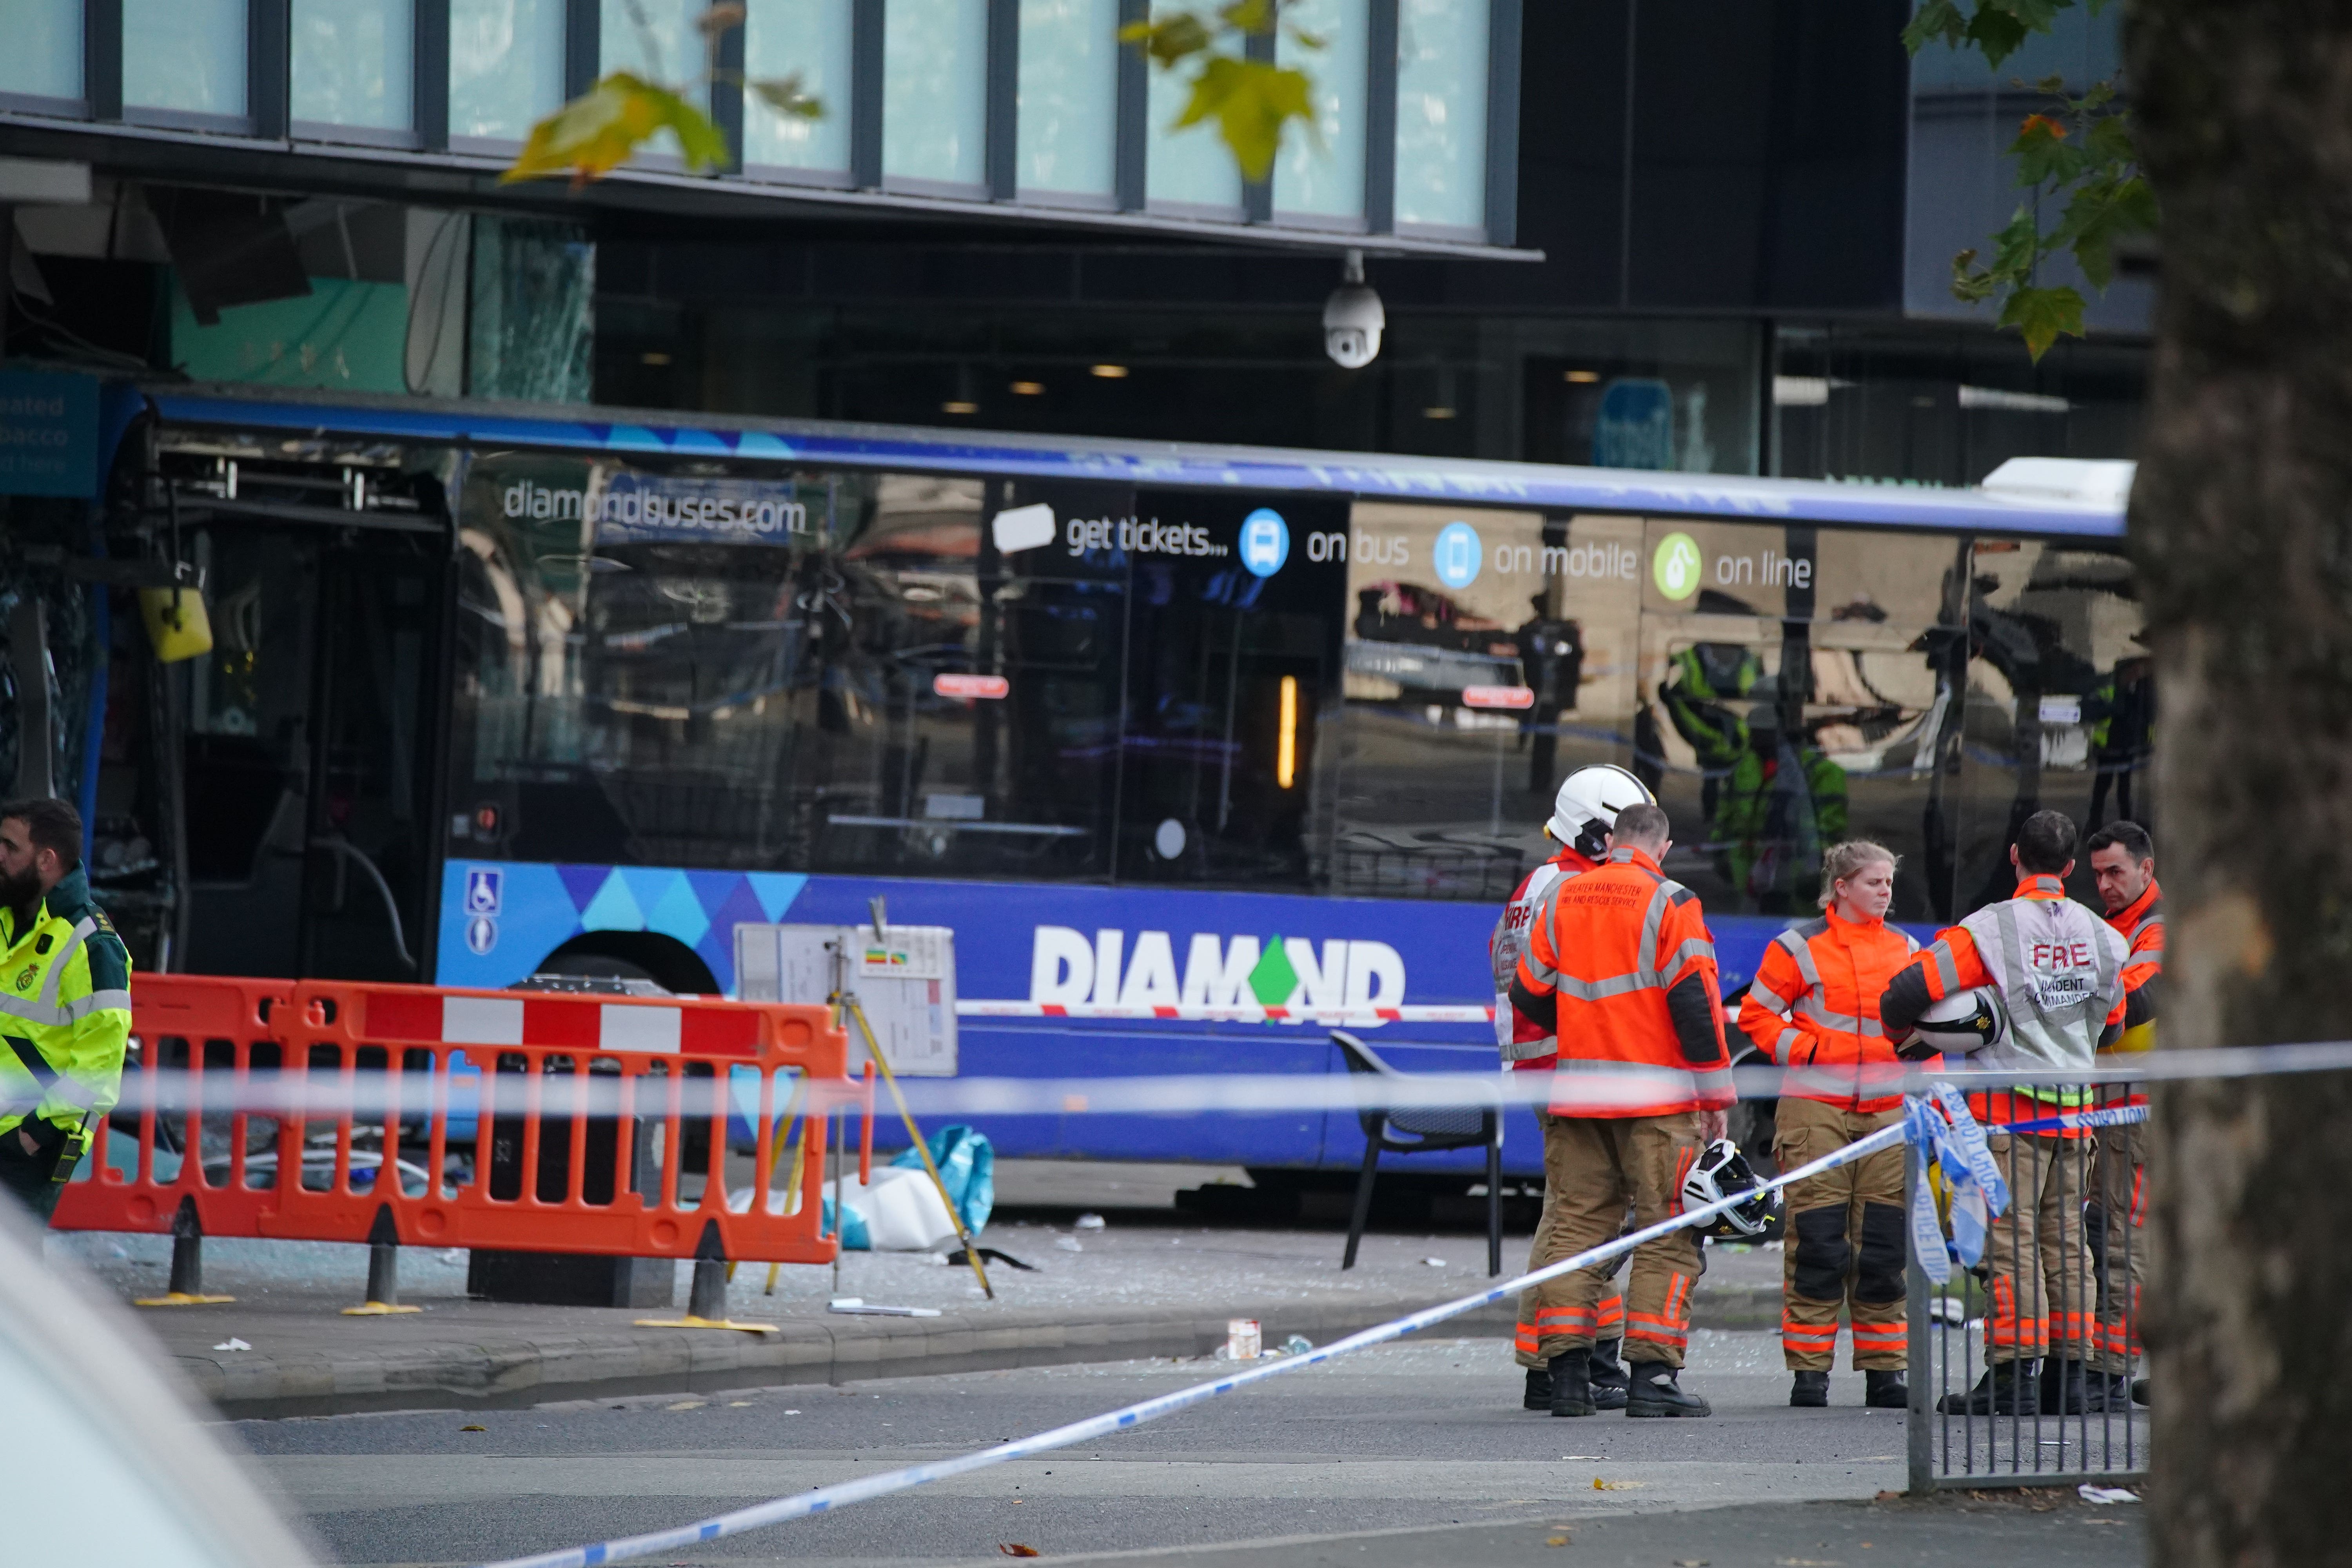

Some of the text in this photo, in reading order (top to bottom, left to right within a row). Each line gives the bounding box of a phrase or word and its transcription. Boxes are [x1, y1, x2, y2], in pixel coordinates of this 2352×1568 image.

[504, 479, 806, 534] diamondbuses.com
[1067, 516, 1811, 588] get tickets... on bus on mobile on line
[1594, 882, 1642, 897] MANCHESTER
